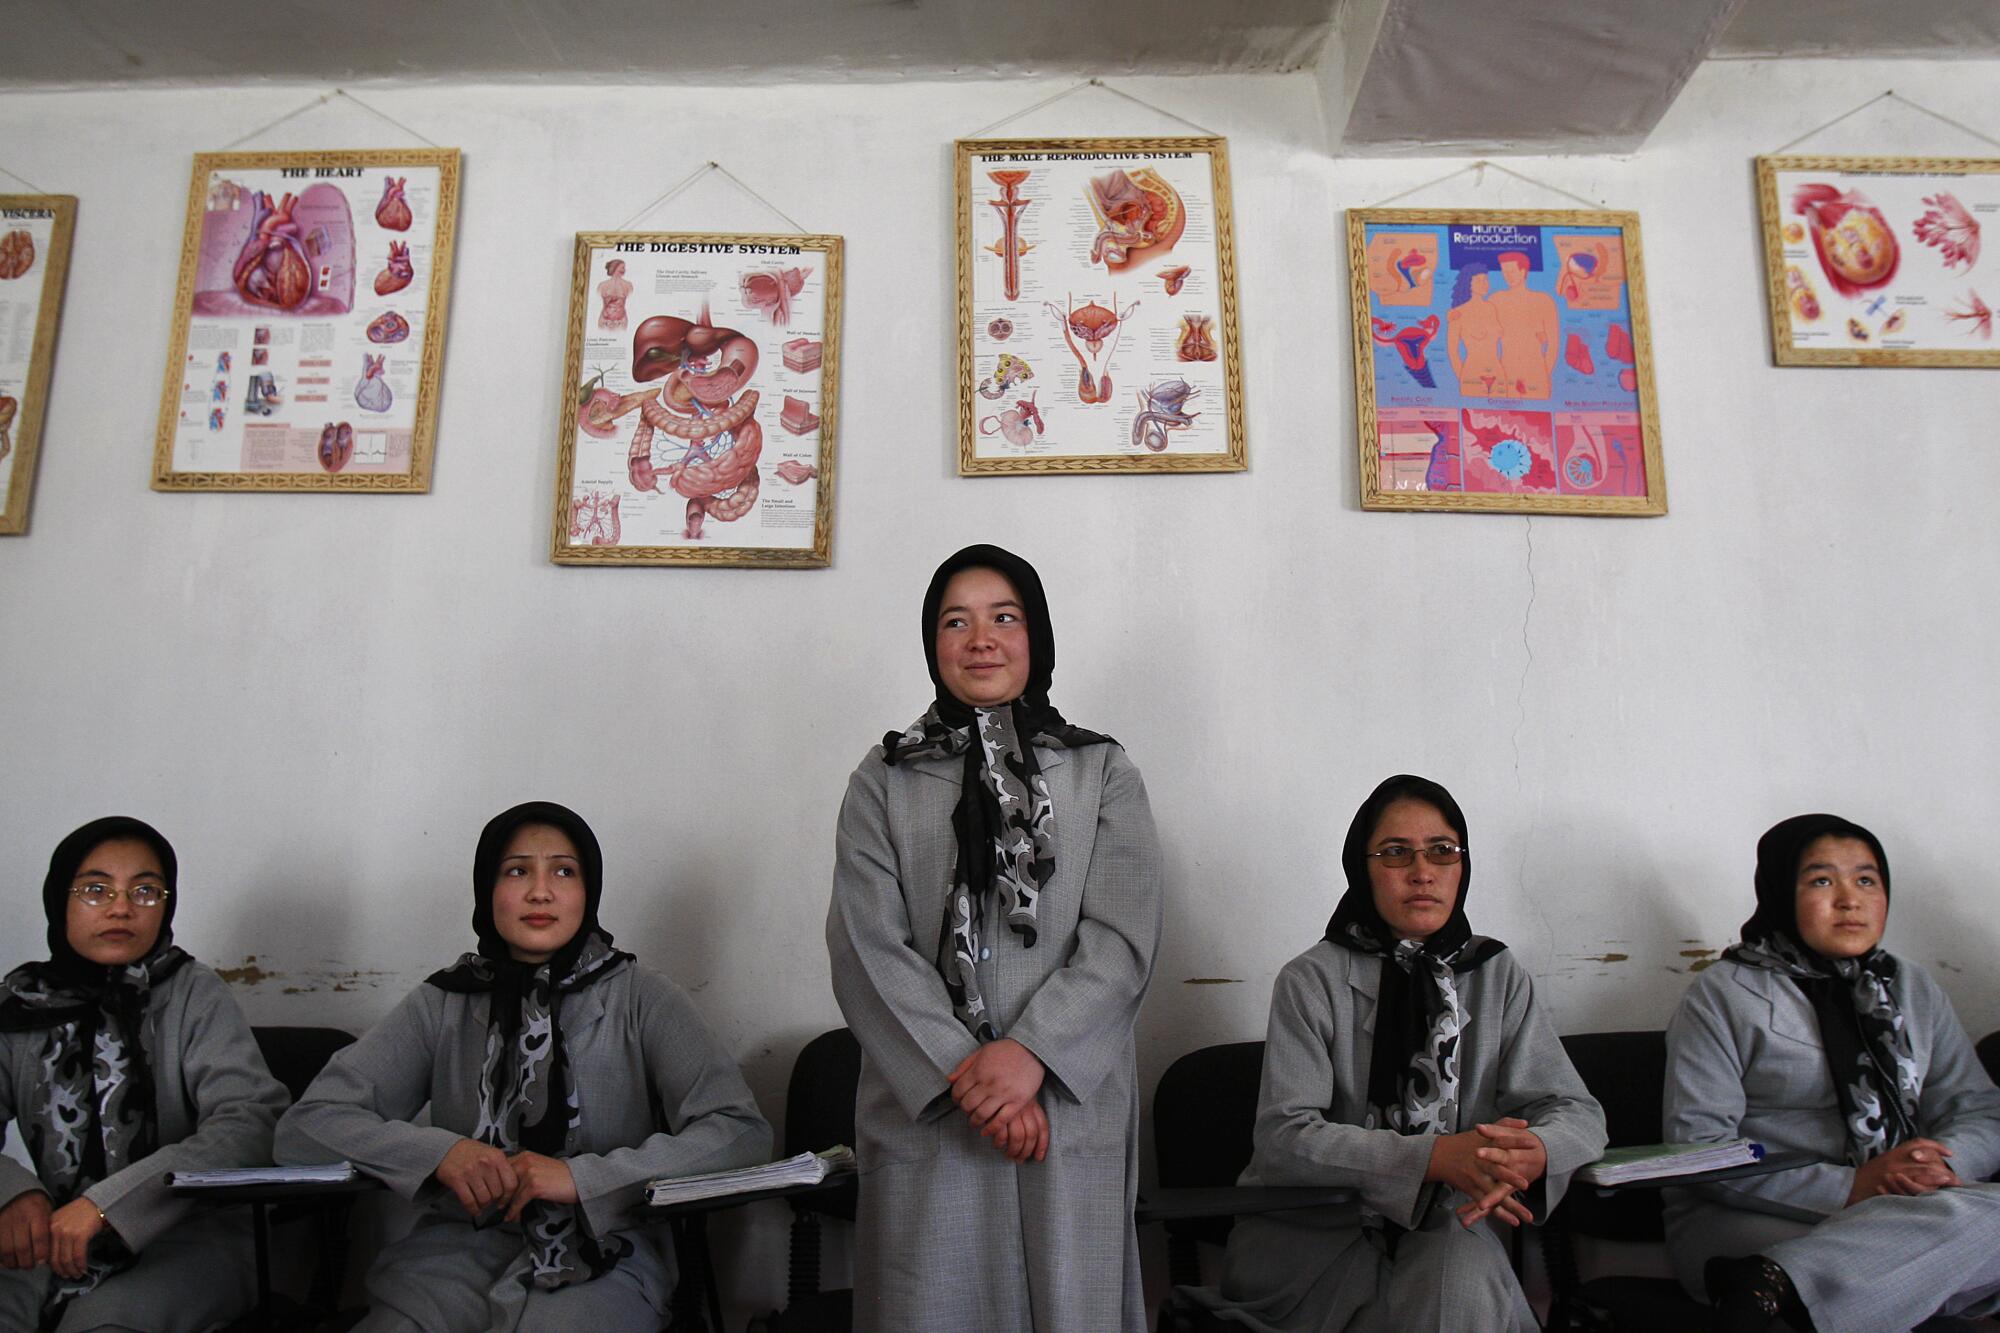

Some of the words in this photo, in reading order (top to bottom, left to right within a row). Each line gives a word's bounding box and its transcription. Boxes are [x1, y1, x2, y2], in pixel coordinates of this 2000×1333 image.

[980, 153, 1005, 162] THE
[1009, 153, 1043, 162] MALE
[1047, 152, 1140, 161] REPRODUCTIVE
[1143, 151, 1193, 160] SYSTEM
[281, 167, 310, 178] THE
[314, 167, 364, 178] HEART
[1472, 224, 1517, 234] Human
[1453, 232, 1537, 245] Reproduction
[615, 242, 645, 252] THE
[650, 242, 734, 254] DIGESTIVE
[738, 243, 801, 255] SYSTEM
